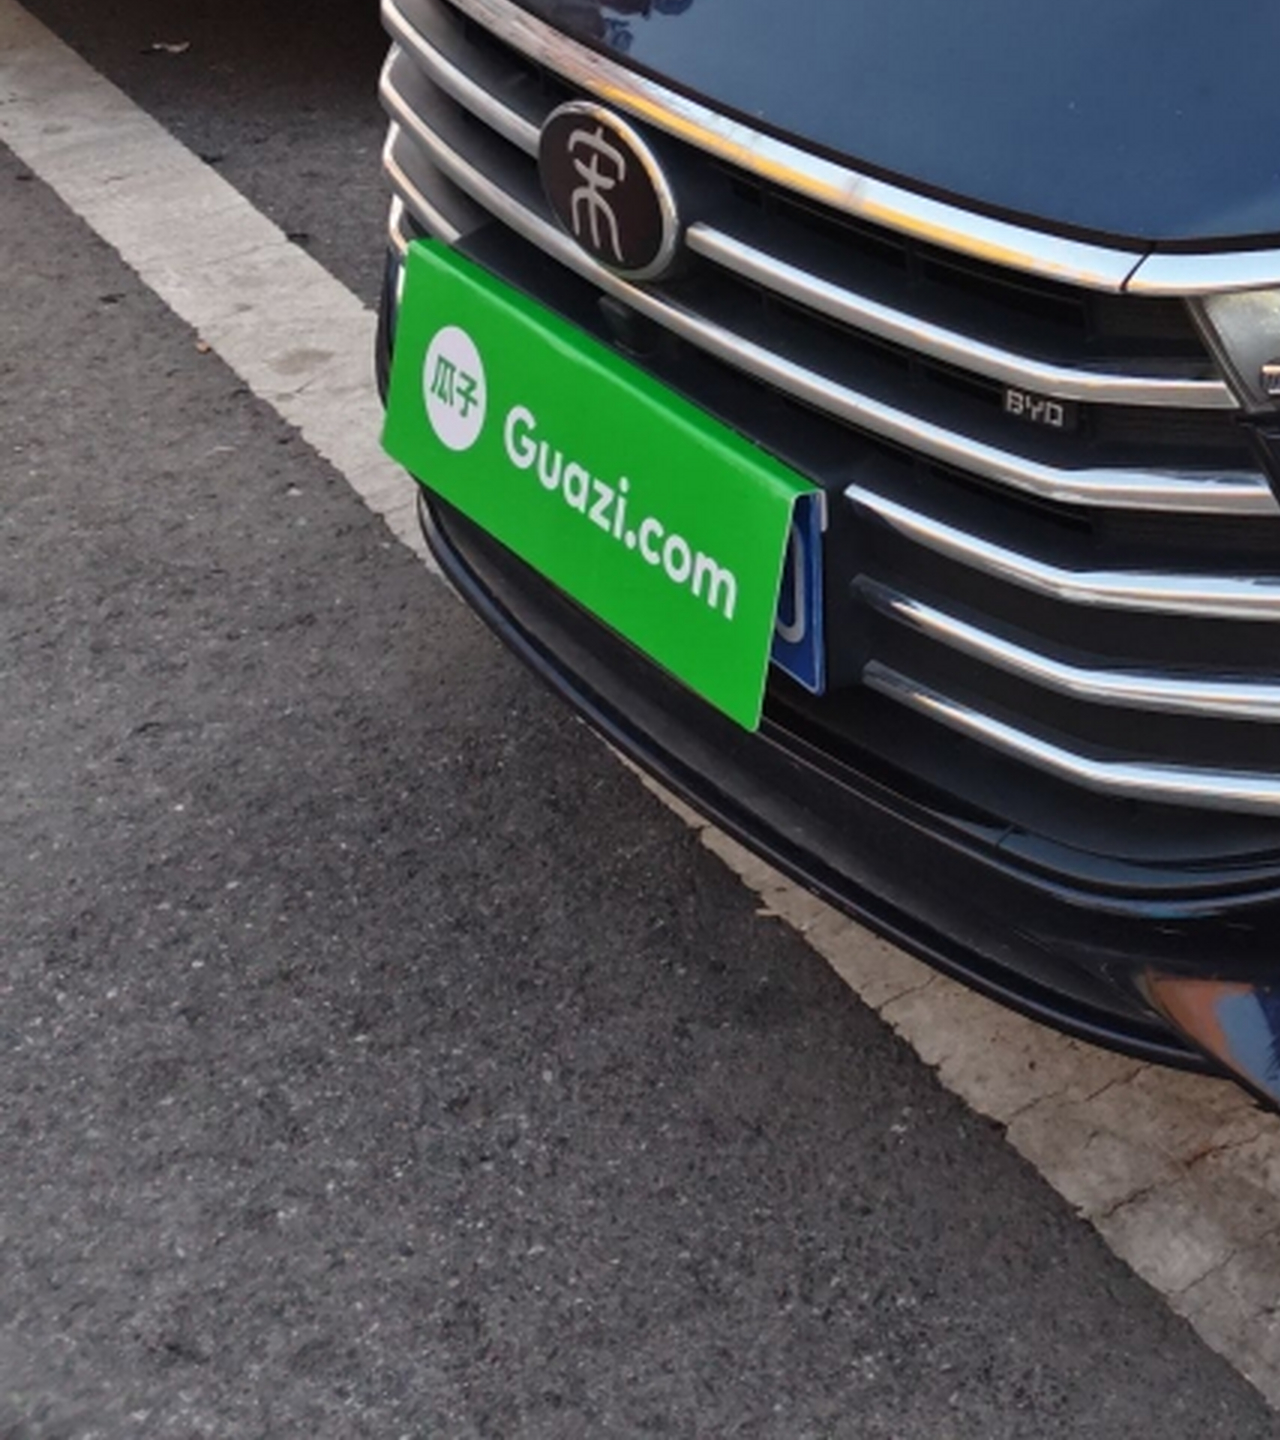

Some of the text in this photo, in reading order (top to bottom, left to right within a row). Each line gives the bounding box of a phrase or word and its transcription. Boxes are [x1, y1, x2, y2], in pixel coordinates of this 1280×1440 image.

[430, 354, 478, 418] 瓜子
[1006, 389, 1064, 427] BYD
[503, 405, 737, 621] Guazi.com
